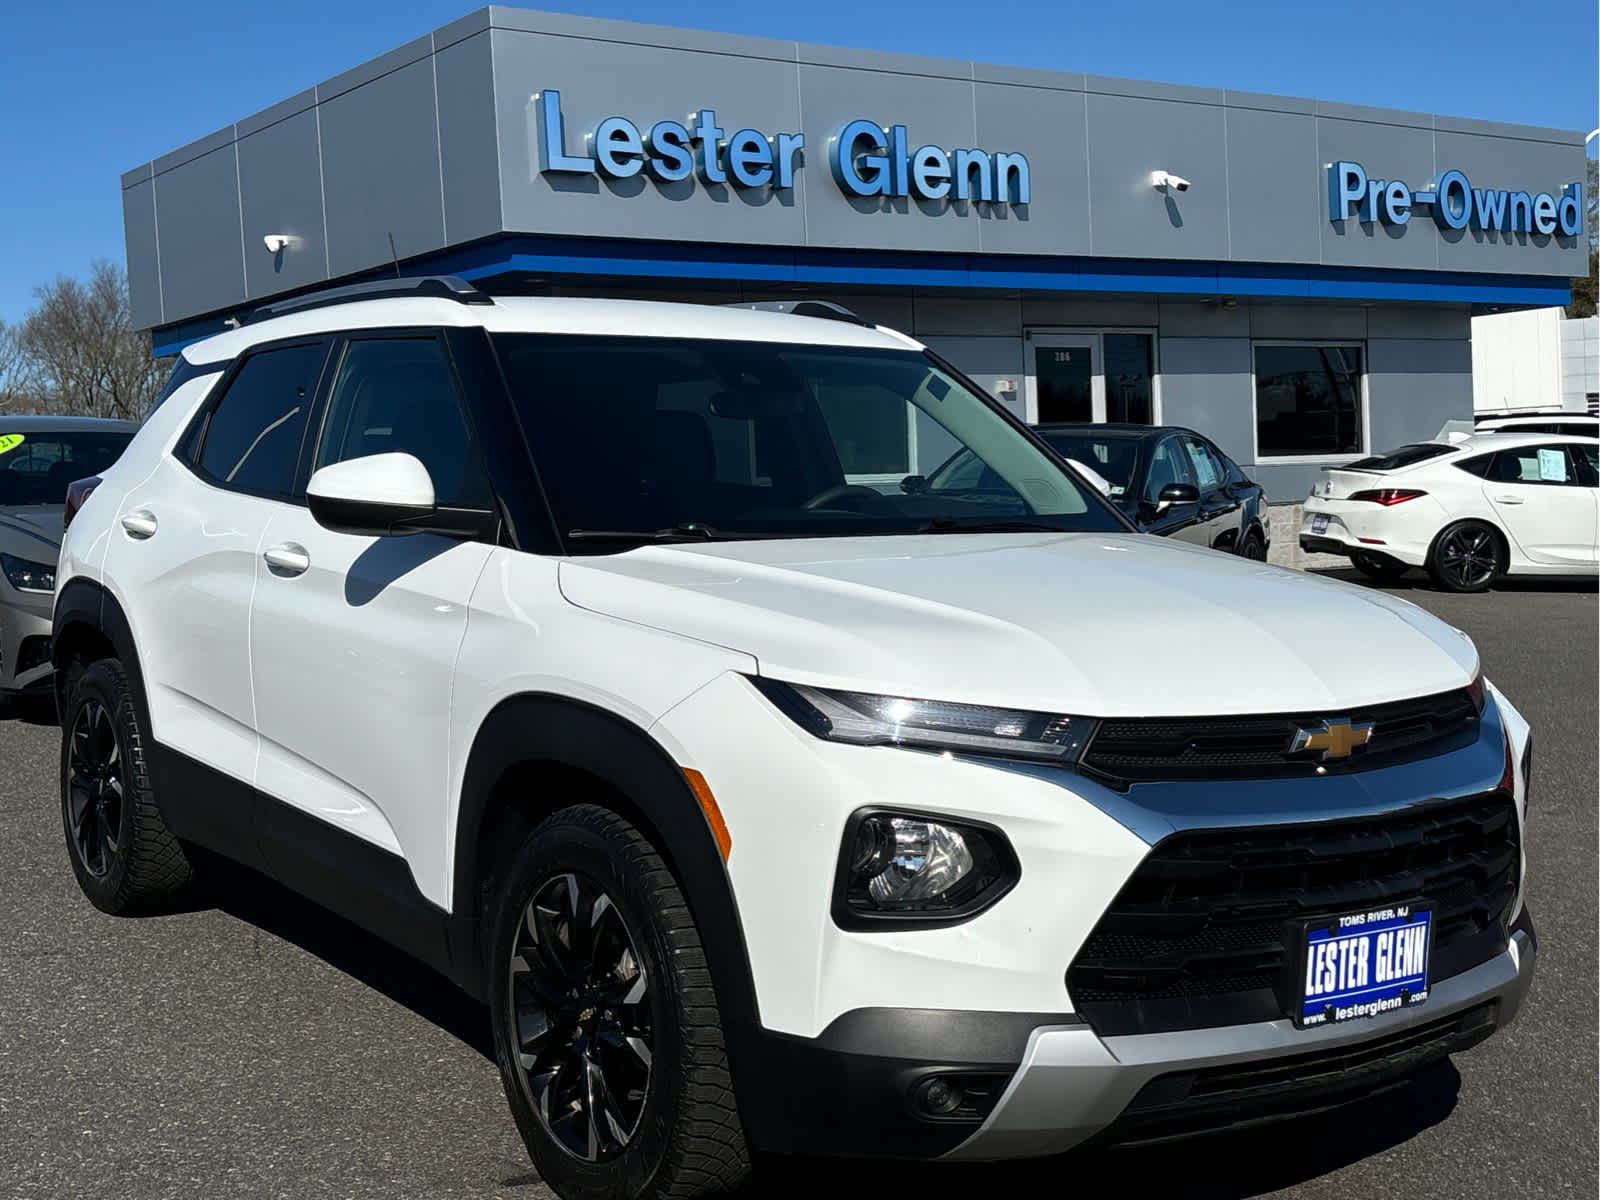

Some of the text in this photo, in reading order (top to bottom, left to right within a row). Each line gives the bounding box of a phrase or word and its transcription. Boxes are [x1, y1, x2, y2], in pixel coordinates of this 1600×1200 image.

[539, 89, 1030, 204] Lester Glenn
[1328, 160, 1582, 236] Pre-Owned
[1339, 913, 1365, 928] TOMS
[1397, 906, 1409, 917] NJ
[1305, 925, 1426, 996] LESTER GLENN
